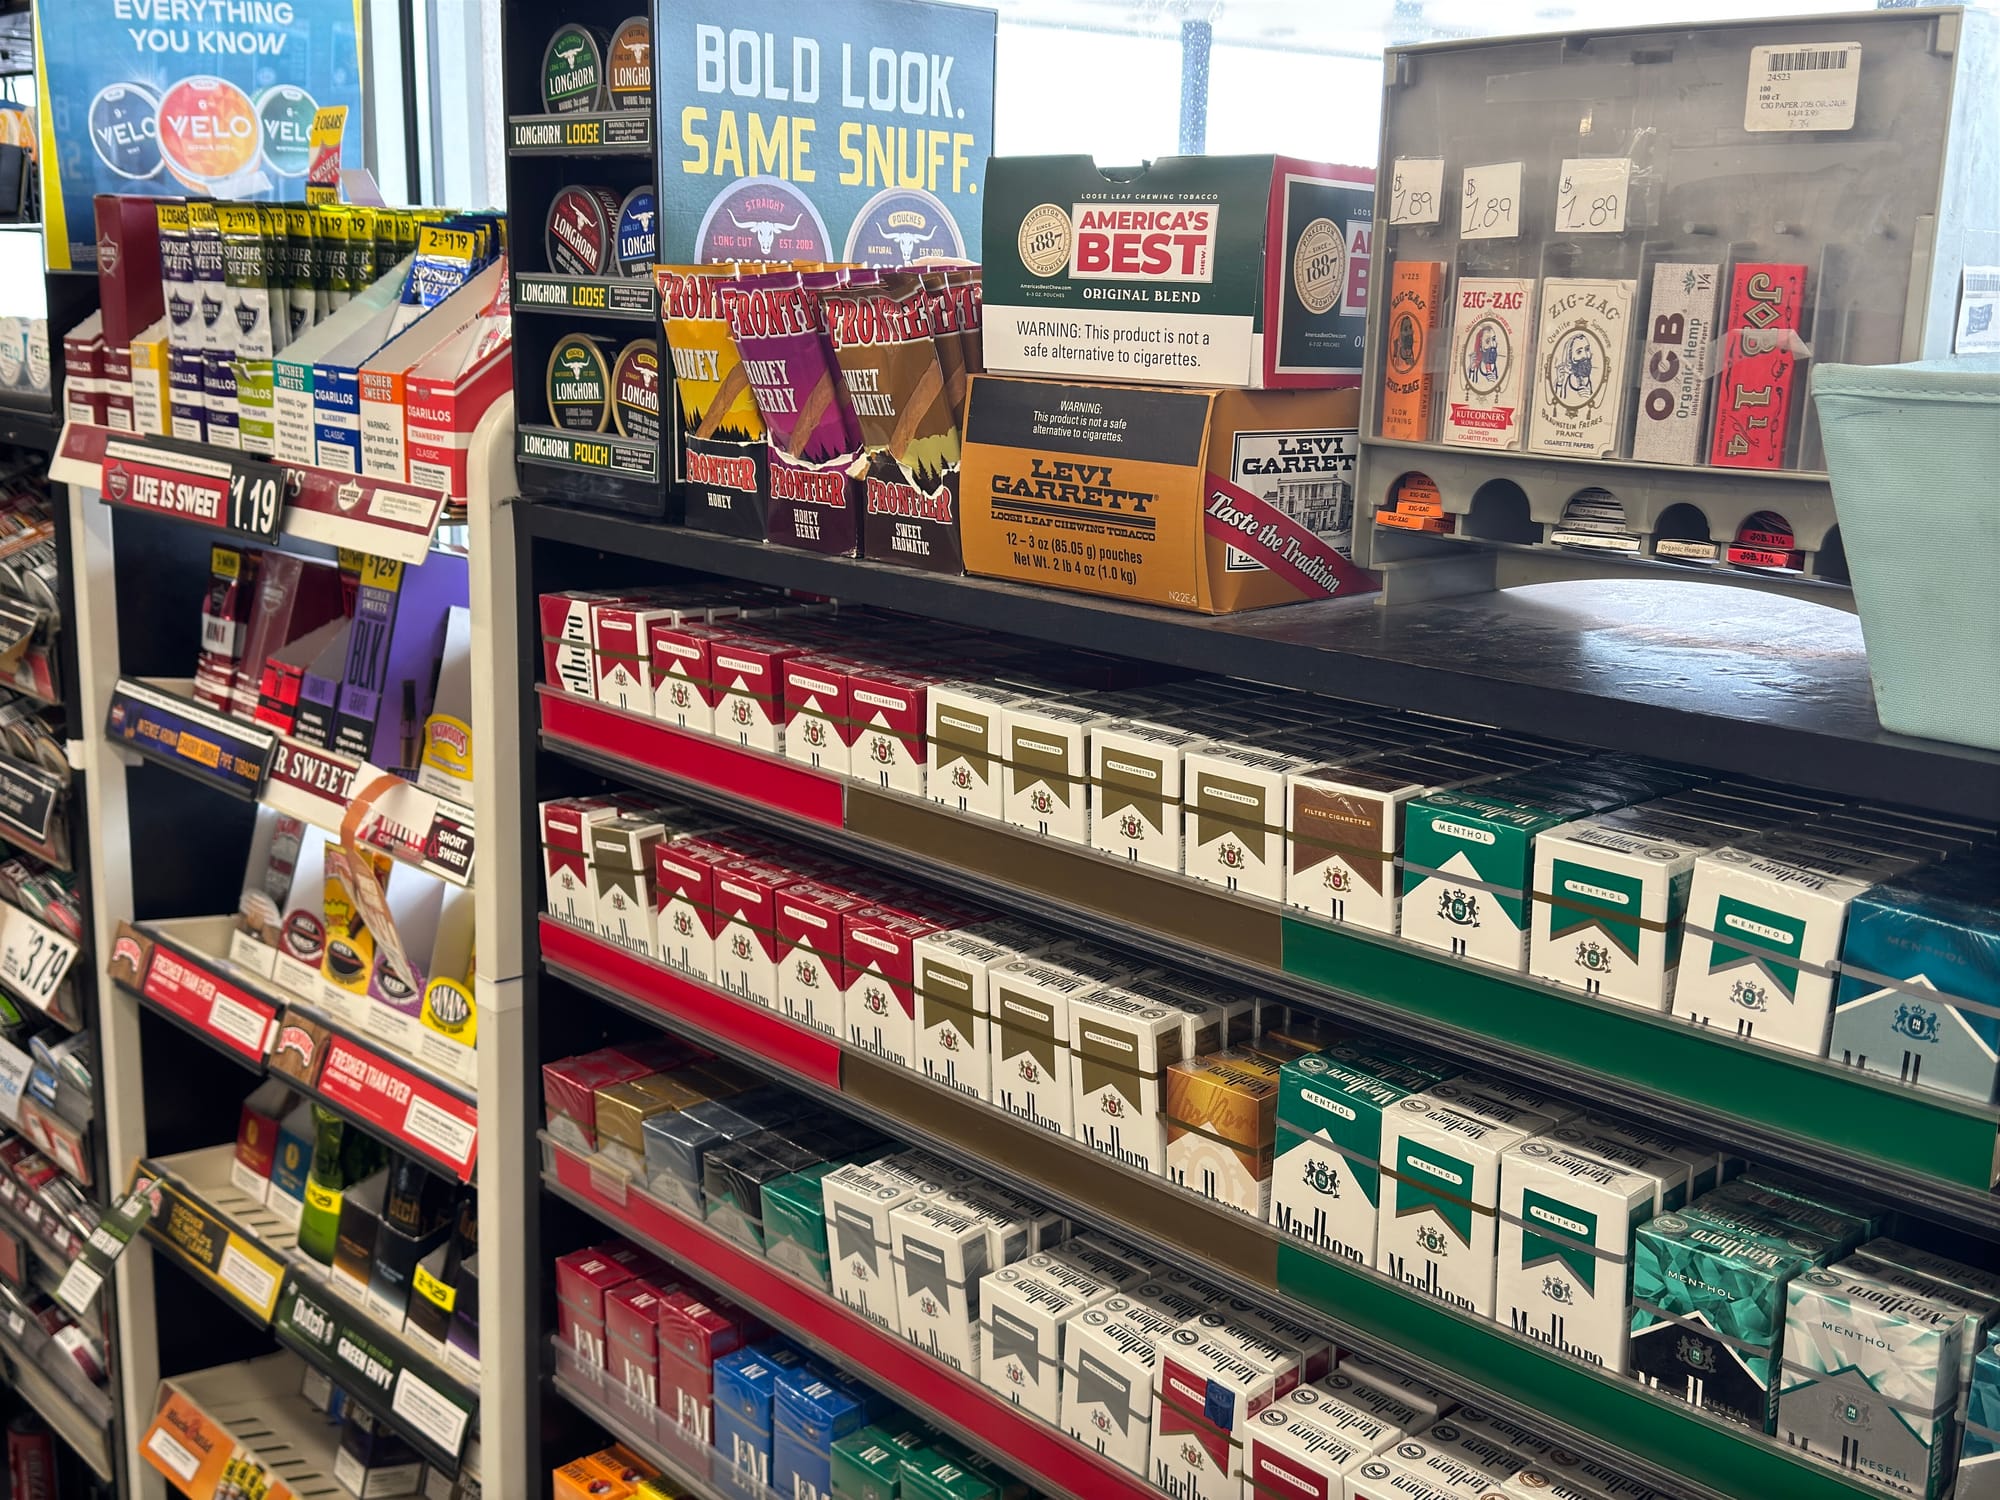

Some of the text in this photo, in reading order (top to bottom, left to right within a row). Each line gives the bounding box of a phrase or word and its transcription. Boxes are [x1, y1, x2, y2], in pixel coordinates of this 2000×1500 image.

[114, 0, 294, 25] EVERYTHING
[128, 29, 287, 55] YOU KNOW
[549, 65, 595, 95] LONGHORN
[697, 23, 965, 119] BOLD LOOK.
[1767, 73, 1791, 81] 24523
[1775, 101, 1798, 109] PAPER
[167, 115, 252, 139] VELO
[314, 114, 343, 129] 2 CIGARS
[515, 125, 561, 144] LONGHORN
[566, 123, 600, 144] LOOSE
[681, 105, 977, 194] SAME SNUFF.
[745, 198, 785, 213] STRAIGHT
[1026, 208, 1060, 227] PINKERTON
[1462, 197, 1511, 234] 1.89
[1561, 194, 1618, 228] 1.89
[892, 214, 922, 225] POUCHES
[1079, 210, 1209, 231] AMERICA'S
[554, 214, 598, 264] LONGHORN
[713, 234, 753, 247] LONG CUT
[779, 238, 814, 250] EST. 2003
[868, 246, 892, 255] NATURAL
[1030, 231, 1063, 254] 1887
[930, 248, 944, 257] 2003
[1077, 232, 1207, 275] BEST
[1306, 255, 1338, 283] 1887
[521, 283, 567, 304] LONGHORN
[573, 286, 605, 307] LOOSE
[1083, 287, 1201, 303] ORIGINAL BLEND
[1392, 290, 1426, 310] ZIG-ZAG
[1463, 291, 1523, 310] ZIG-ZAG
[1549, 293, 1620, 321] ZIG-ZAG
[1741, 272, 1783, 357] JOB
[1016, 320, 1210, 347] WARNING: This product is not a
[1023, 343, 1201, 368] safe alternative to cigarettes.
[1645, 312, 1685, 421] OCB
[278, 365, 304, 378] SWISHER
[1676, 318, 1701, 419] Organic Hemp
[279, 377, 304, 390] SWEETS
[362, 374, 392, 388] SWISHER
[556, 382, 600, 400] LONGHORN
[1386, 379, 1420, 395] ZIG-ZAG
[315, 389, 354, 405] CIGARILLOS
[363, 387, 391, 401] SWEETS
[408, 405, 451, 422] CIGARILLOS
[1456, 410, 1505, 422] KUTCORNERS
[1279, 436, 1345, 455] LEVI
[1543, 439, 1594, 449] CIGARETTE PAPERS
[1556, 429, 1584, 438] FRANCE
[524, 435, 570, 458] LONGHORN
[574, 442, 608, 466] POUCH
[686, 449, 757, 492] FRONTIER
[1031, 458, 1113, 487] LEVI
[132, 474, 221, 519] LIFE IS SWEET
[770, 463, 846, 508] FRONTIER
[991, 474, 1155, 514] GARRETT
[231, 473, 277, 535] $1.19
[707, 492, 732, 509] HONEY
[867, 476, 953, 524] FRONTIER
[793, 508, 818, 525] HONEY
[990, 510, 1156, 542] LOOSE LEAF CHEWING TOBACCO
[796, 523, 820, 540] BERRY
[895, 522, 922, 540] SWEET
[1207, 490, 1342, 595] Taste the Tradition
[891, 536, 930, 556] AROMATIC
[1006, 532, 1143, 566] 12 3 oz (85.05 g) pouches
[1013, 551, 1138, 586] Net Wt. 2 lb 4 oz (1.0 kg)
[348, 619, 386, 692] BLK
[790, 676, 836, 694] FILTER CIGARETTES
[856, 691, 905, 709] FILTER CIGARETTES
[290, 751, 354, 800] SWEET
[1304, 807, 1372, 827] FILTER CIGARETTES
[438, 830, 467, 850] SHORT
[1438, 822, 1488, 842] MENTHOL
[437, 845, 467, 868] SWEET
[1571, 883, 1623, 902] MENTHOL
[1730, 917, 1789, 941] MENTHOL
[20, 934, 68, 996] 3.79
[851, 1023, 906, 1066] Marlboro
[1001, 1089, 1062, 1134] Marlboro
[1306, 1092, 1351, 1118] MENTHOL
[1082, 1123, 1149, 1172] Marlboro
[1412, 1158, 1458, 1182] MENTHOL
[1275, 1201, 1364, 1264] Marlboro
[1535, 1209, 1585, 1233] MENTHOL
[1700, 1213, 1759, 1238] BOLD ICE
[1387, 1253, 1475, 1313] Marlboro
[1667, 1270, 1735, 1301] MENTHOL
[1846, 1285, 1945, 1325] Marlboro
[1511, 1307, 1604, 1368] Marlboro
[1822, 1321, 1896, 1353] MENTHOL
[1859, 1457, 1911, 1482] RESEAL
